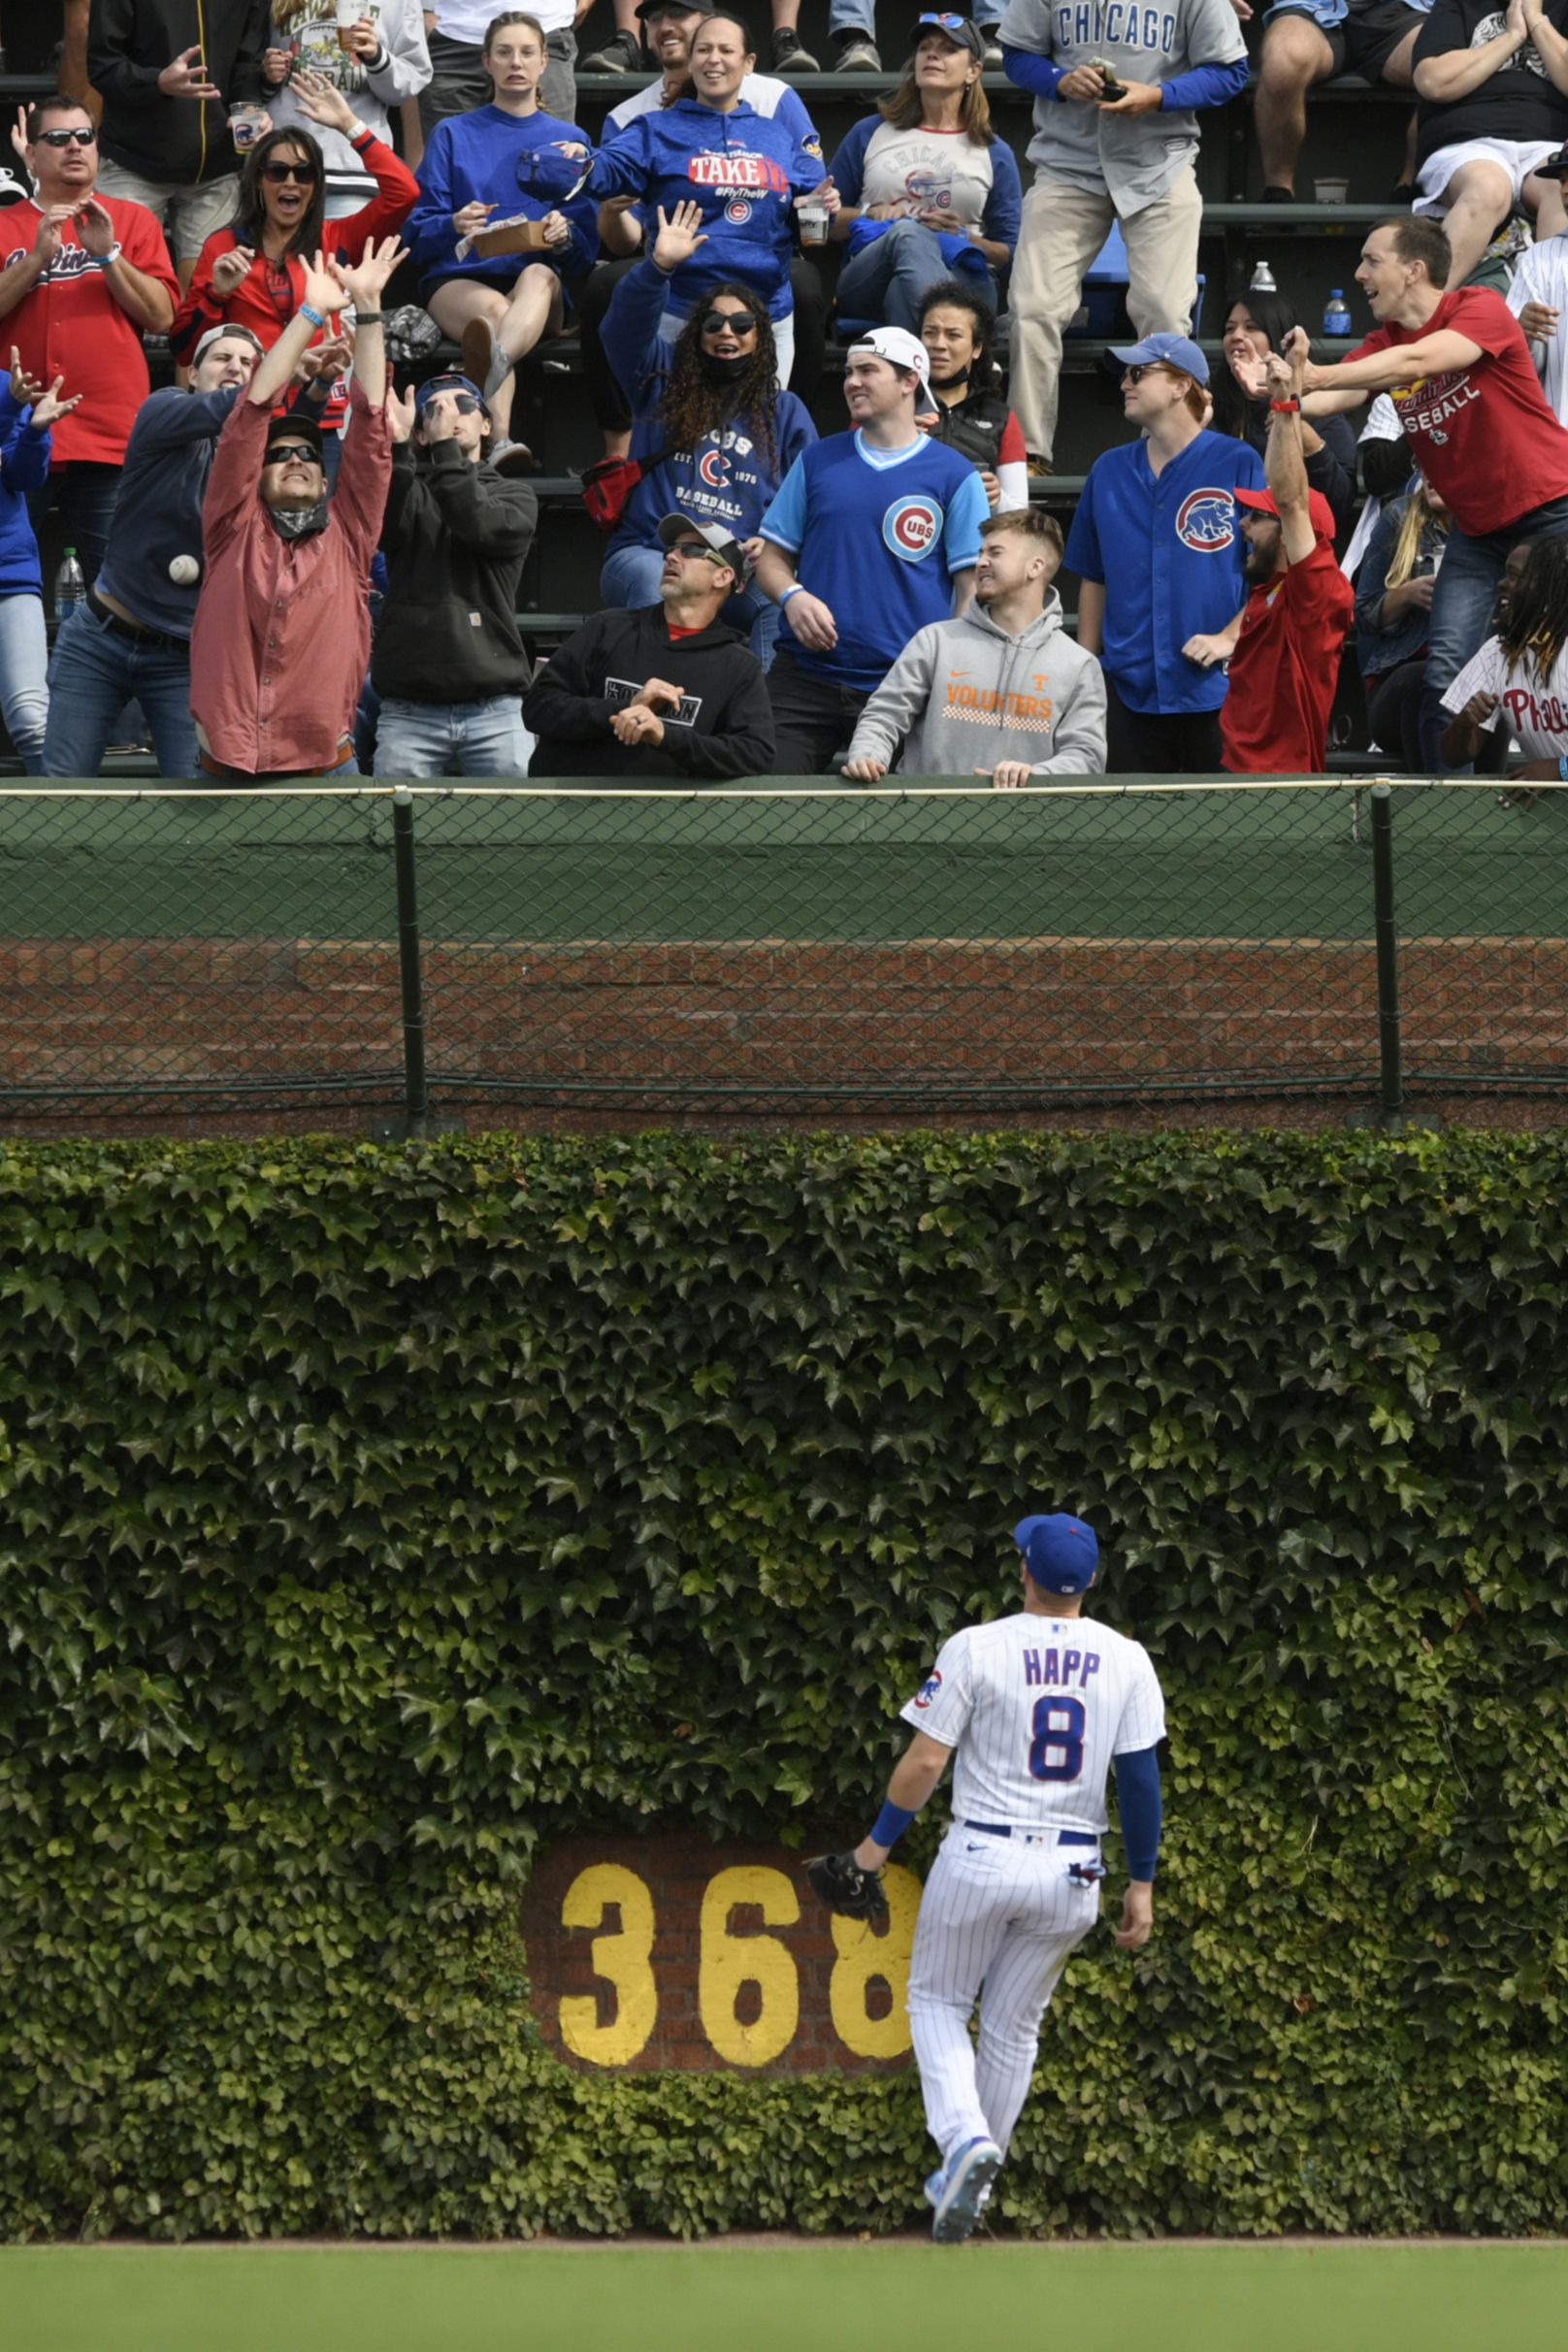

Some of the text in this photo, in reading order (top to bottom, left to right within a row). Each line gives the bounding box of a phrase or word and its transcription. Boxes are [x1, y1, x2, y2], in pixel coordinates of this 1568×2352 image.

[1059, 2, 1176, 55] CHICAGO
[691, 156, 762, 185] TAKE
[1404, 384, 1481, 434] SEBALL
[675, 486, 743, 517] BASEBALL
[1023, 1648, 1101, 1689] HAPP
[1029, 1695, 1086, 1782] 8
[559, 1862, 925, 2069] 368
